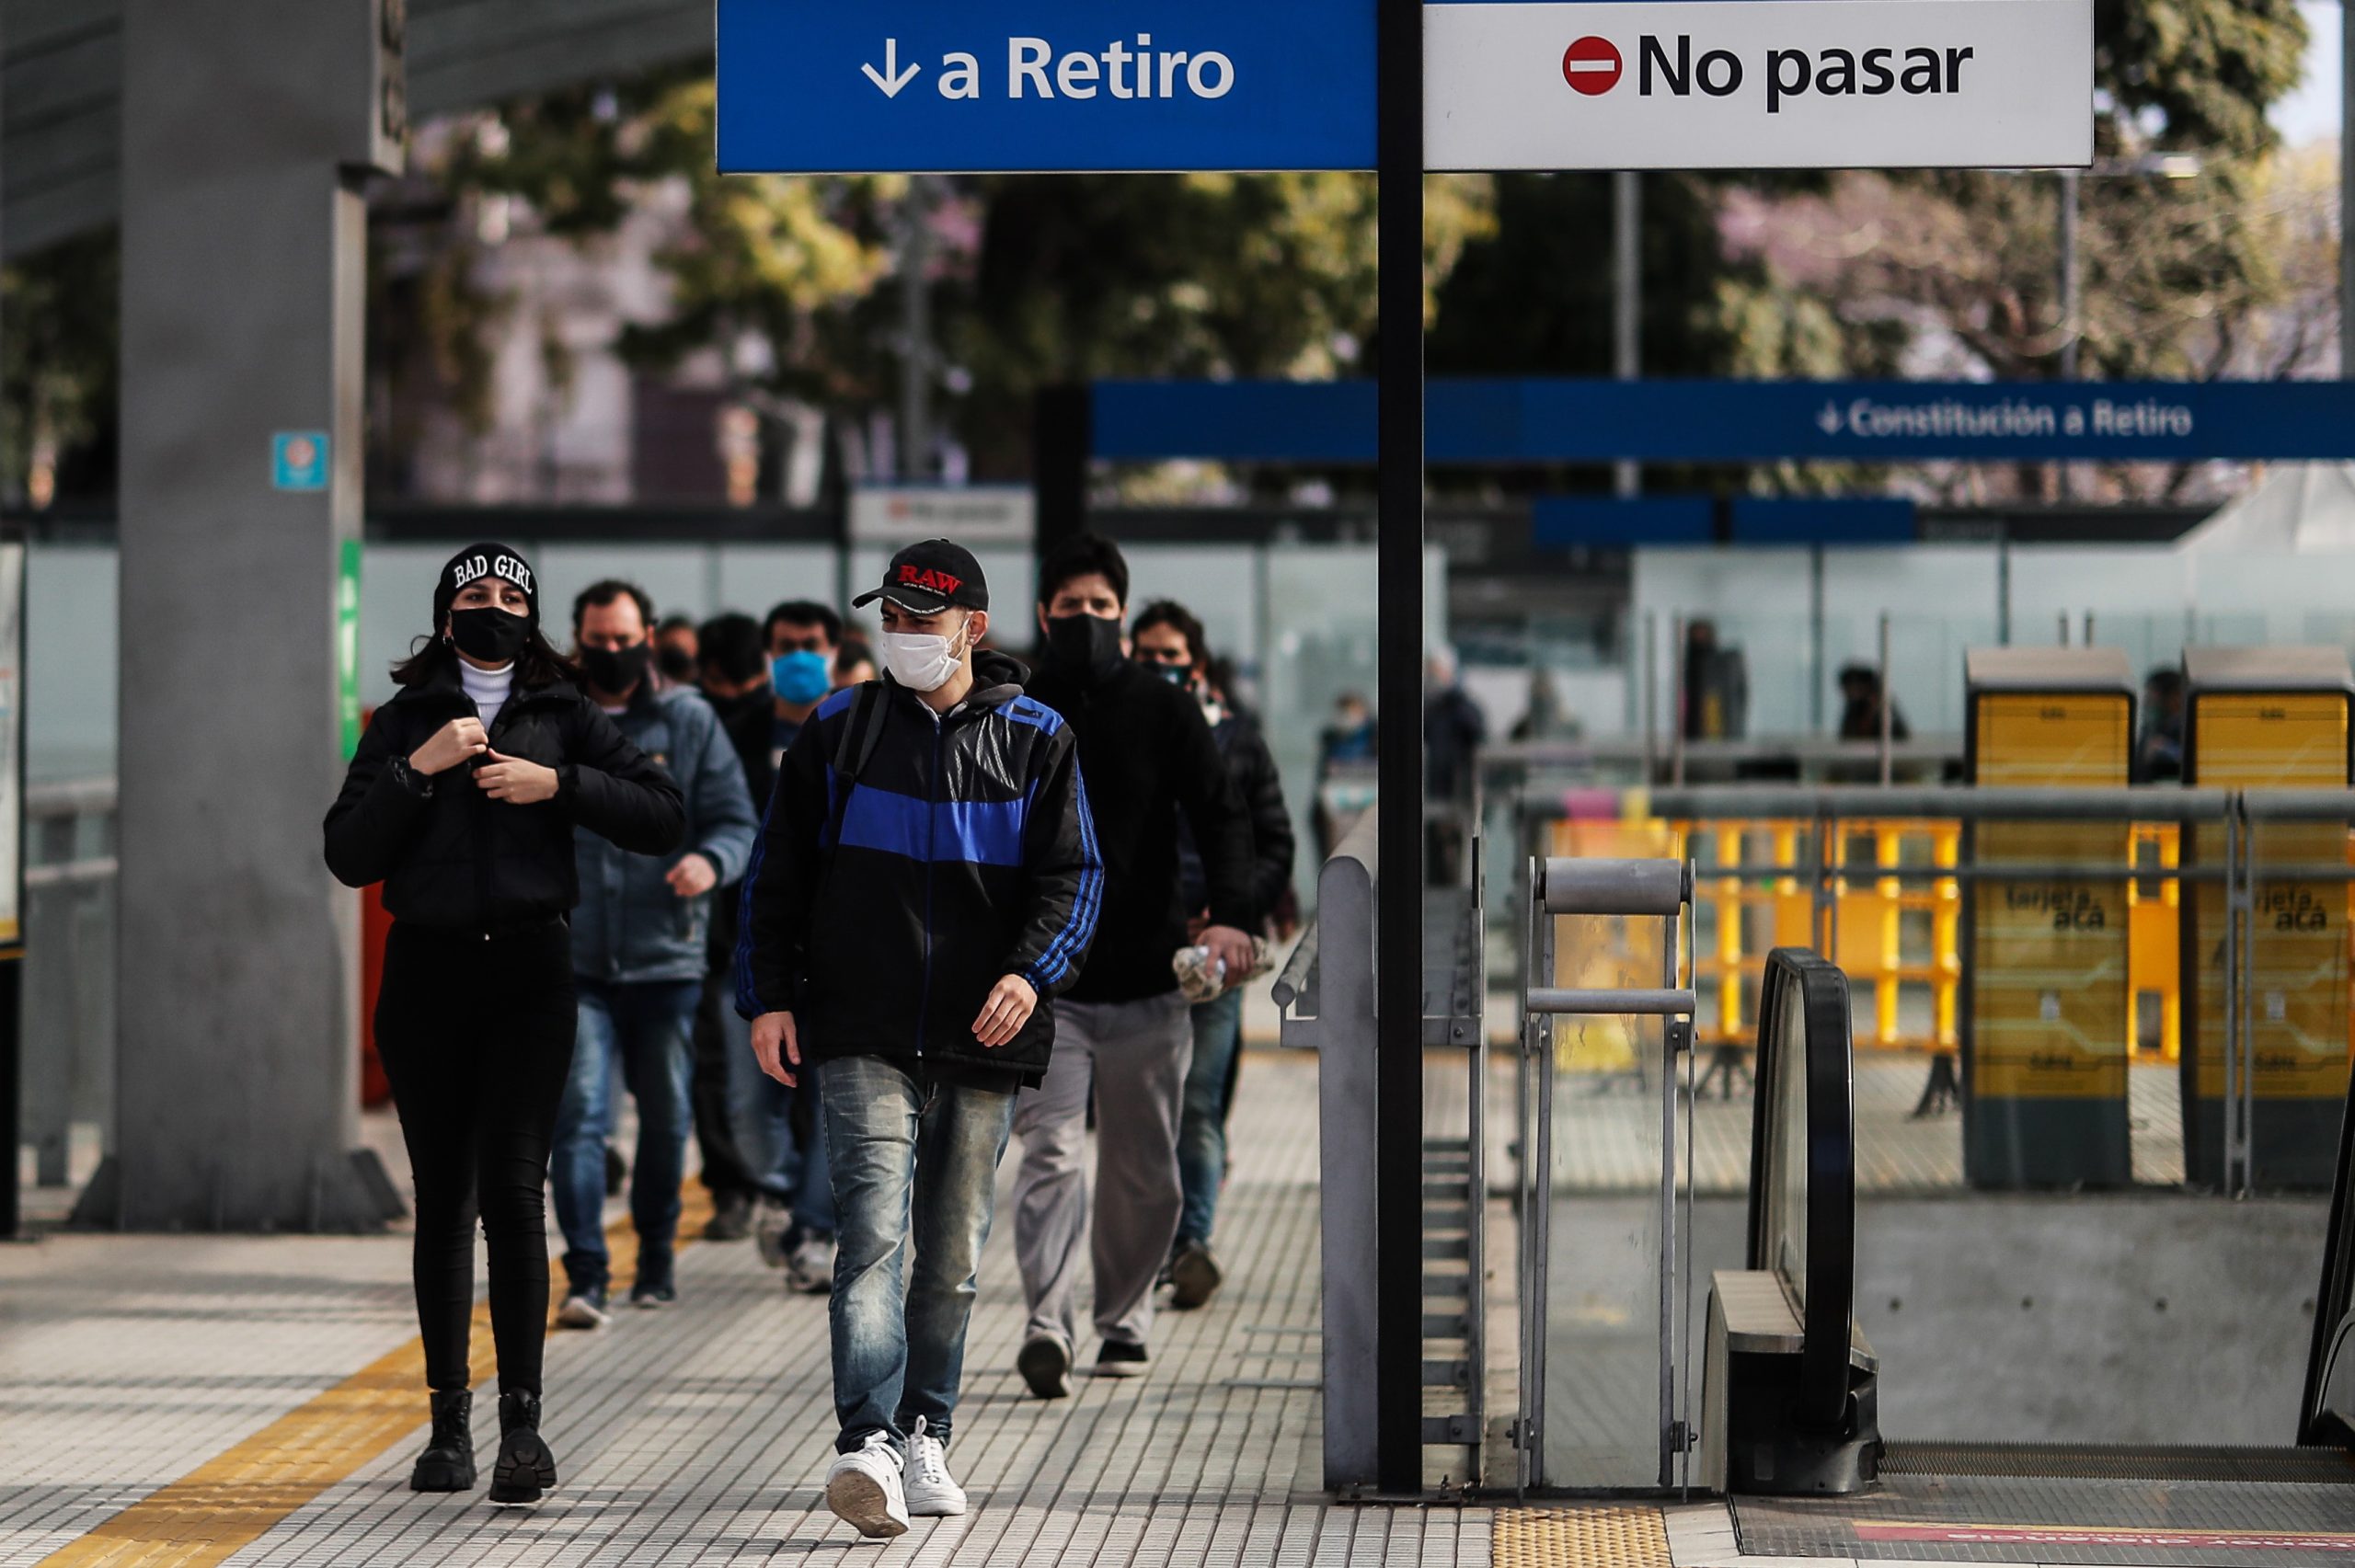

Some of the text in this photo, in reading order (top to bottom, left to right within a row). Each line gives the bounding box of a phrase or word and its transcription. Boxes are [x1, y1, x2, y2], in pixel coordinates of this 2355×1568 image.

[937, 32, 1235, 99] a Retiro
[1639, 34, 1974, 114] No pasar
[1848, 397, 2193, 436] Constitución a Retiro
[454, 555, 533, 595] BAD GIRL
[898, 565, 963, 595] RAW
